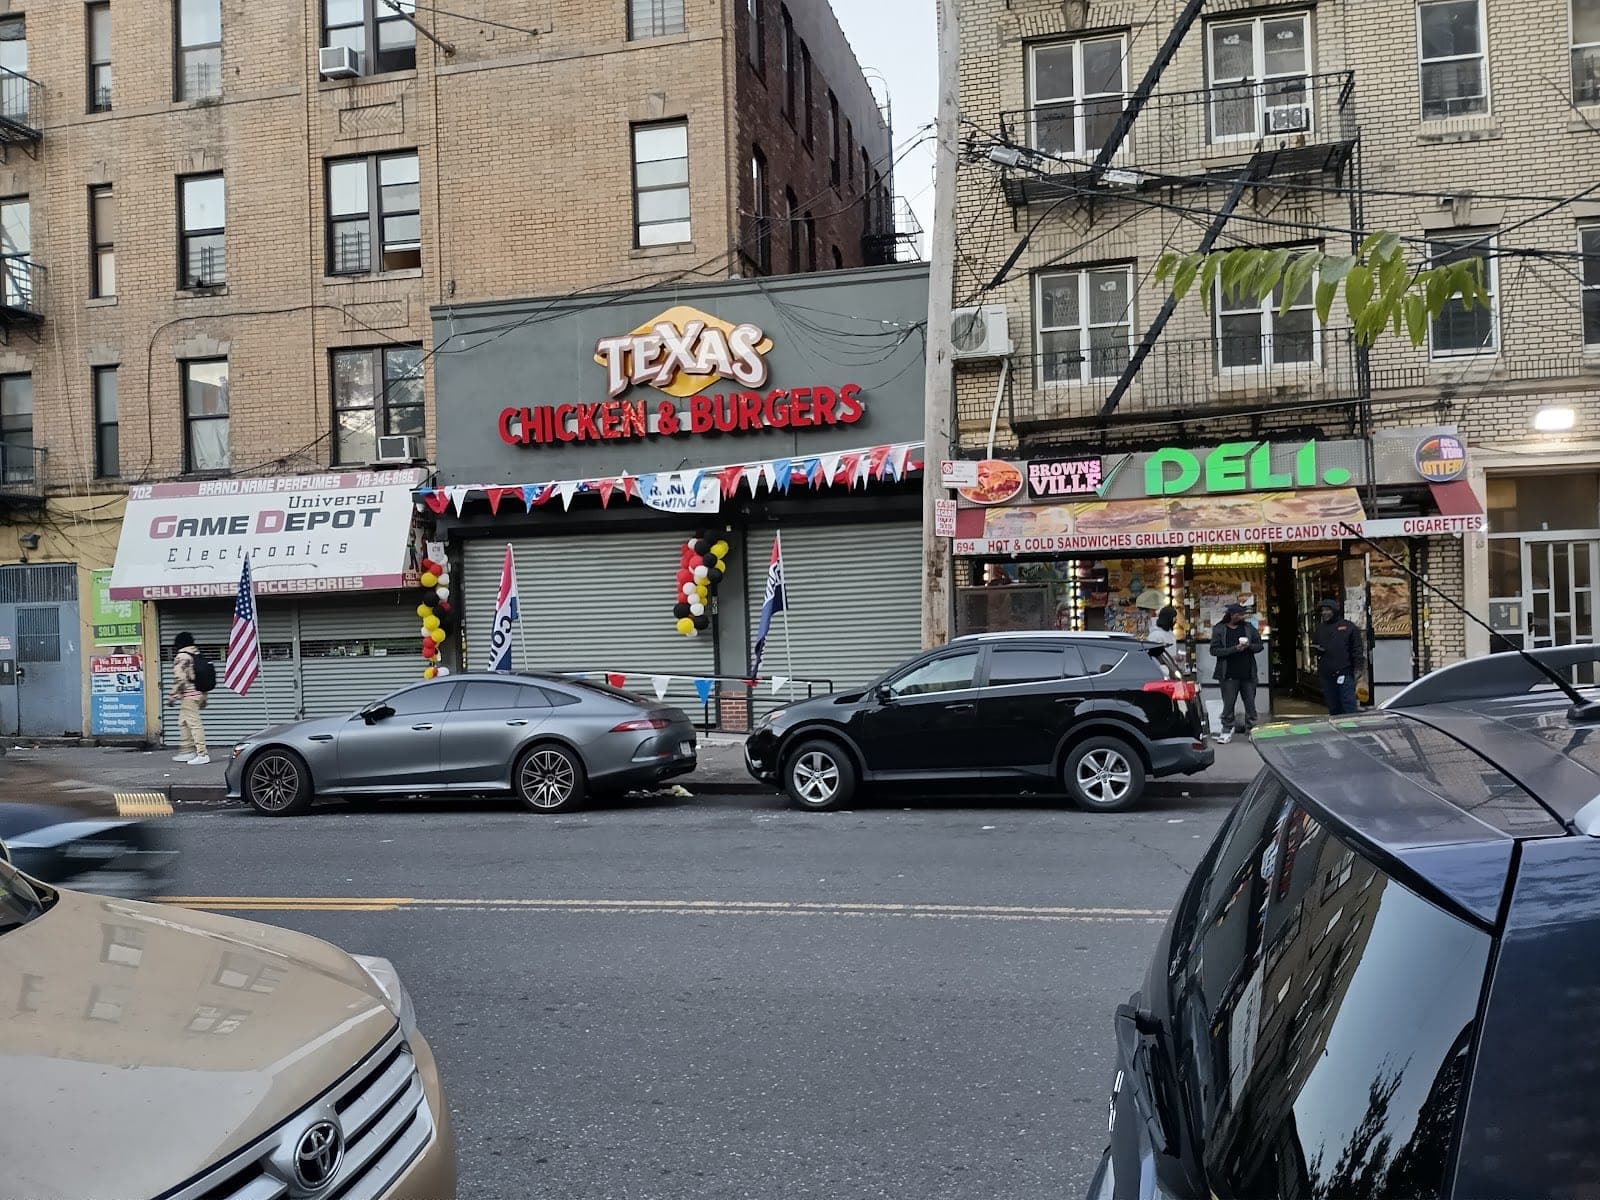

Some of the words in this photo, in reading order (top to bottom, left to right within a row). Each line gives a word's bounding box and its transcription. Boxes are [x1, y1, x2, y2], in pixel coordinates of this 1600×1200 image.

[596, 320, 769, 398] TEXAS
[498, 399, 648, 446] CHICKEN
[657, 400, 681, 436] &
[690, 383, 865, 434] BURGERS
[1029, 460, 1101, 477] BROWNS
[132, 486, 153, 500] 702
[198, 480, 239, 496] BRAND
[240, 479, 275, 494] NAME
[276, 475, 341, 491] PERFUMES
[1029, 473, 1102, 495] VILLE
[288, 490, 384, 509] Universal
[150, 514, 250, 540] GAME
[255, 507, 382, 534] DEPOT
[956, 542, 975, 552] 694
[988, 539, 1010, 552] HOT
[1014, 539, 1021, 551] &
[1024, 537, 1054, 551] COLD
[1057, 533, 1132, 549] SANDWICHES
[1135, 531, 1184, 546] GRILLED
[1188, 528, 1240, 544] CHICKEN
[1244, 526, 1283, 541] COFEE
[1286, 524, 1328, 538] CANDY
[1331, 522, 1364, 537] SODA
[1403, 516, 1483, 533] CIGARETTES
[167, 540, 348, 563] Electronics
[143, 585, 179, 599] CELL
[181, 582, 239, 597] PHONES
[257, 576, 363, 593] ACCESSORIES
